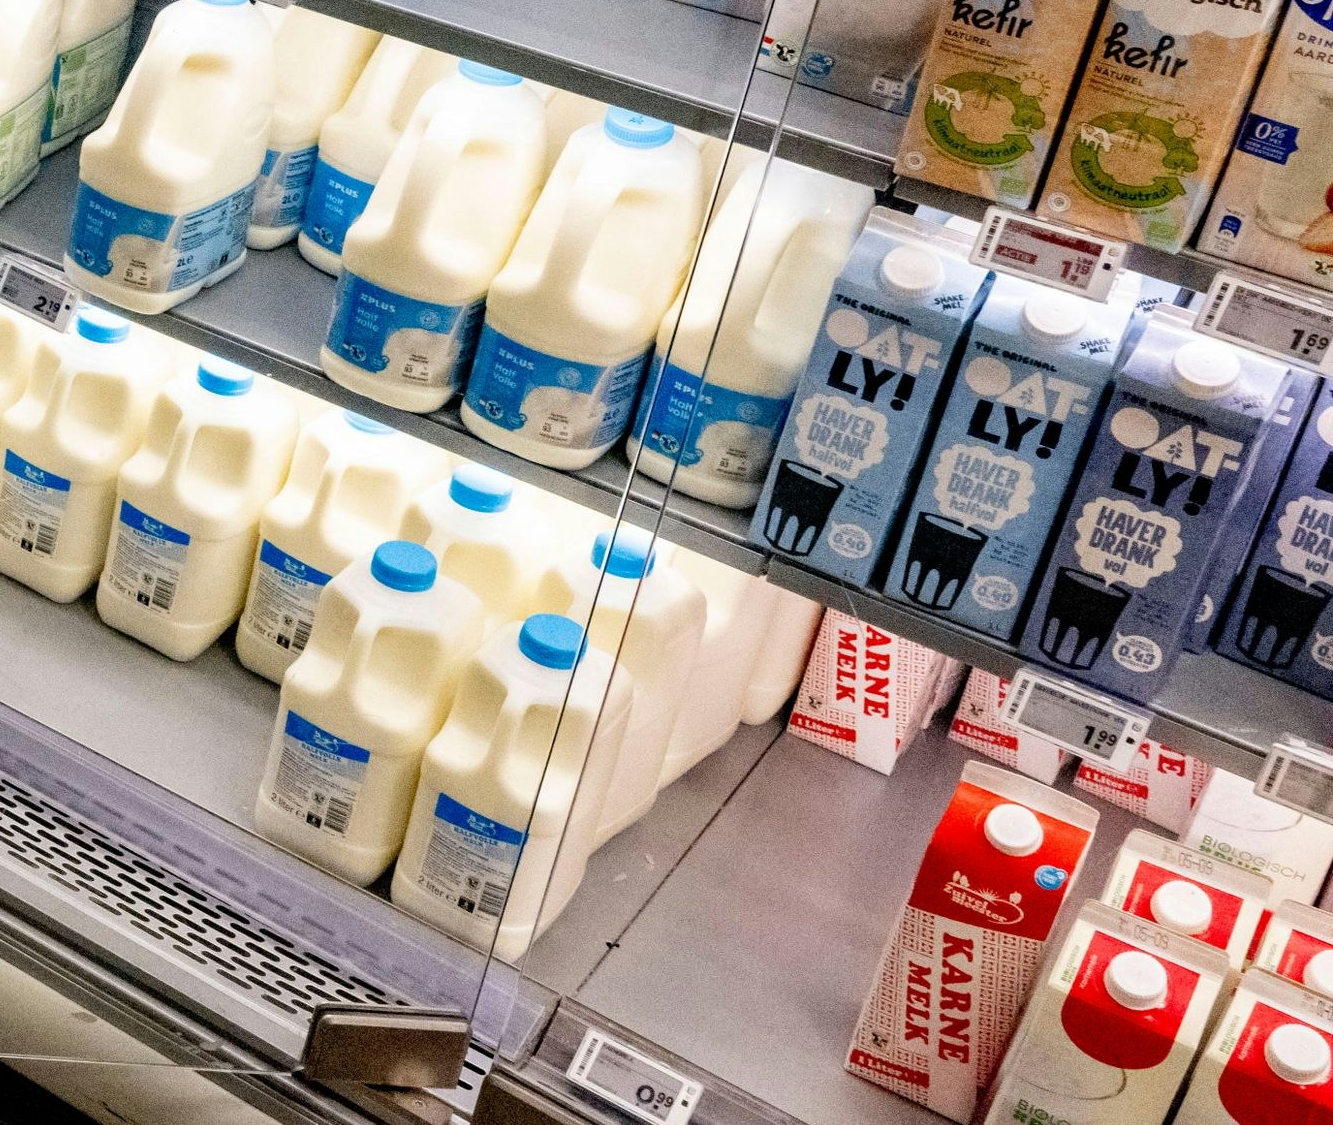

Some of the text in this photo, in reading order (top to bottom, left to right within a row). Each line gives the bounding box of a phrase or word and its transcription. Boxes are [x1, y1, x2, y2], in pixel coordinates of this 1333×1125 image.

[943, 27, 993, 48] NATUREL
[1103, 22, 1188, 77] kefir
[1092, 65, 1144, 88] NATUREL
[34, 296, 61, 316] 2.19
[834, 293, 912, 326] THE ORIGINAL
[934, 294, 964, 306] SHAKE
[974, 340, 1058, 373] THE ORIGINAL
[1079, 337, 1112, 352] SHAKE
[1290, 328, 1330, 355] 1.69
[826, 351, 918, 412] LY!
[813, 401, 875, 439] HAVER
[1121, 391, 1209, 425] THE ORIGINAL
[807, 422, 872, 463] DRANK
[966, 400, 1063, 460] LY!
[808, 445, 854, 472] halfvol
[952, 449, 1019, 491] HAVER
[945, 472, 1018, 513] DRANK
[1109, 461, 1215, 517] LY!
[949, 498, 998, 523] halfvol
[1096, 505, 1166, 546] HAVER
[1089, 528, 1161, 569] DRANK
[1101, 556, 1128, 577] vol
[1304, 557, 1330, 577] vol
[834, 628, 858, 704] MELK
[863, 623, 890, 719] ARNE
[1083, 723, 1118, 753] 1.99
[278, 798, 294, 814] liter
[905, 960, 932, 1046] MELK
[938, 930, 975, 1066] KARNE
[636, 1085, 675, 1110] 0.99
